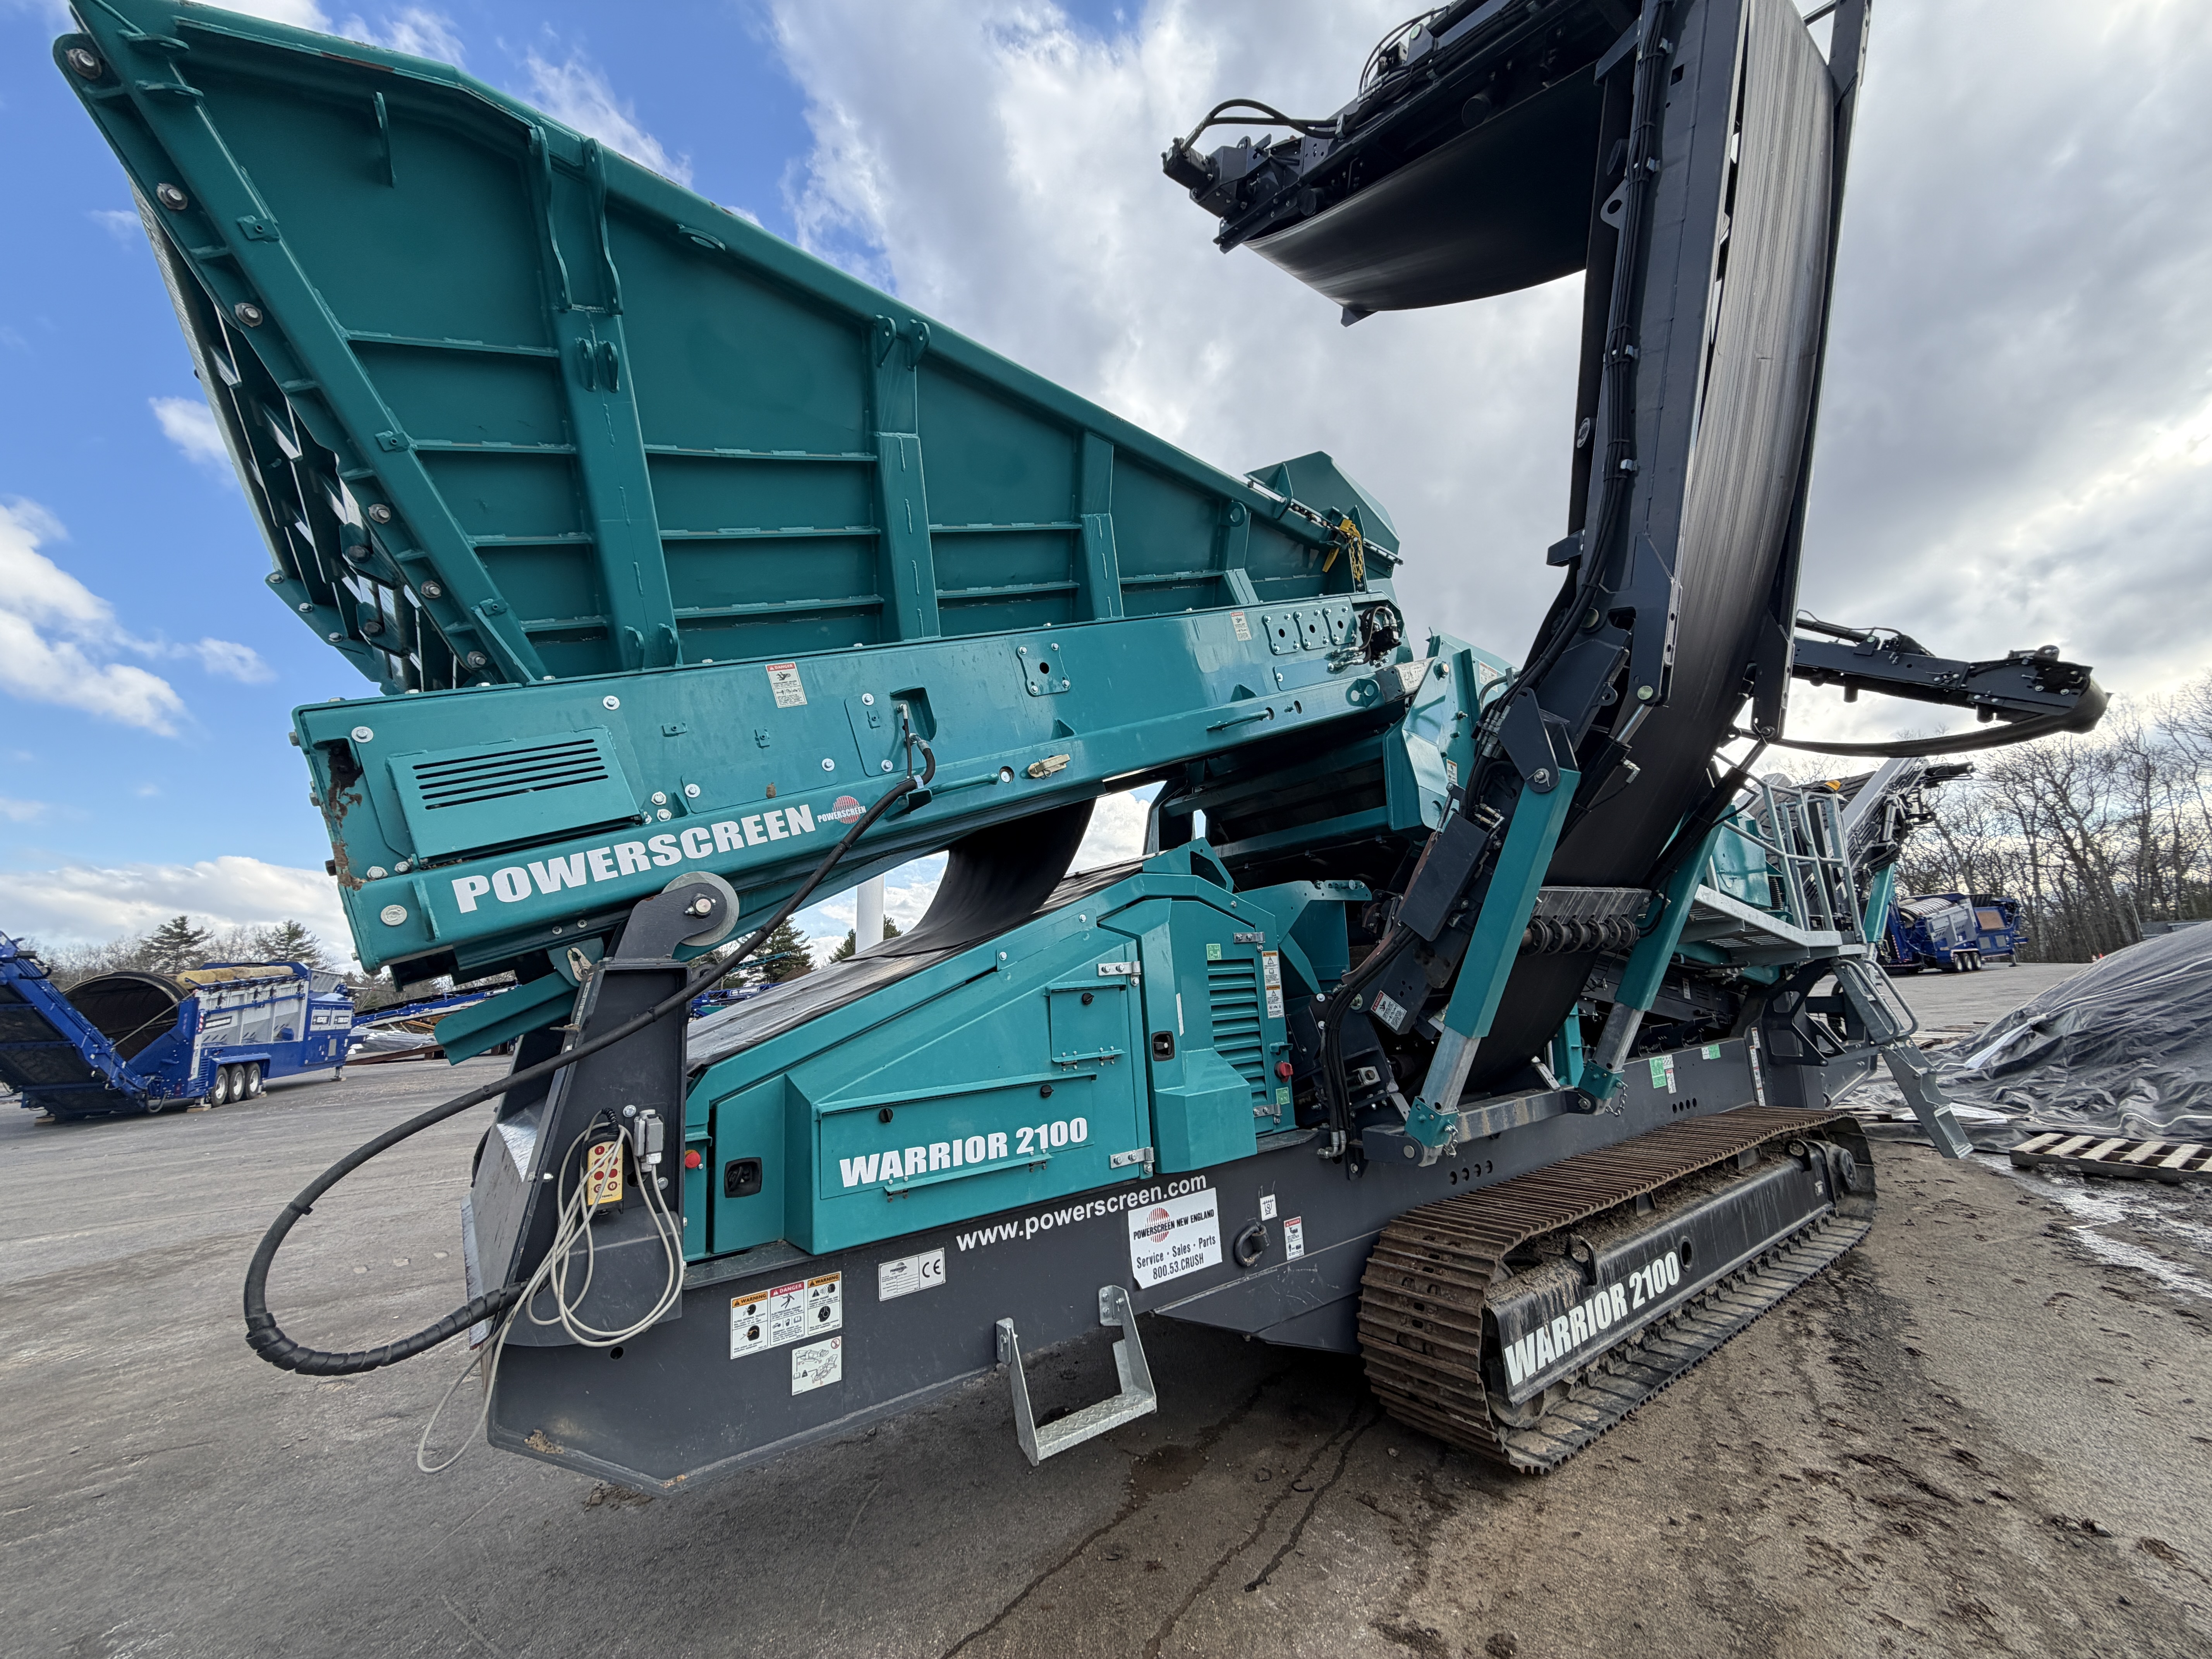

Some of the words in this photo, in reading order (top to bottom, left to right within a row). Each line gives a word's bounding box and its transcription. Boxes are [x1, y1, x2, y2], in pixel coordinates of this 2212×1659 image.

[817, 805, 867, 823] POWERSCREEN
[452, 804, 816, 914] POWERSCREEN
[839, 1132, 1008, 1187] WARRIOR
[1016, 1117, 1088, 1154] 2100
[956, 1175, 1207, 1251] www.powerscreen.com
[1133, 1221, 1175, 1240] POWERSCREEN
[1176, 1216, 1189, 1228] NEW
[1190, 1209, 1214, 1223] ENGLAND
[1137, 1252, 1164, 1269] Service
[1172, 1243, 1191, 1257] Sales
[1199, 1235, 1216, 1249] Parts
[1153, 1253, 1204, 1279] 800.53.CRUSH
[815, 1275, 839, 1285] WARNING
[922, 1259, 941, 1278] CE
[741, 1293, 766, 1304] WARNING
[780, 1283, 802, 1294] DANGER
[1504, 1282, 1628, 1387] WARRIOR
[1629, 1251, 1680, 1310] 2100
